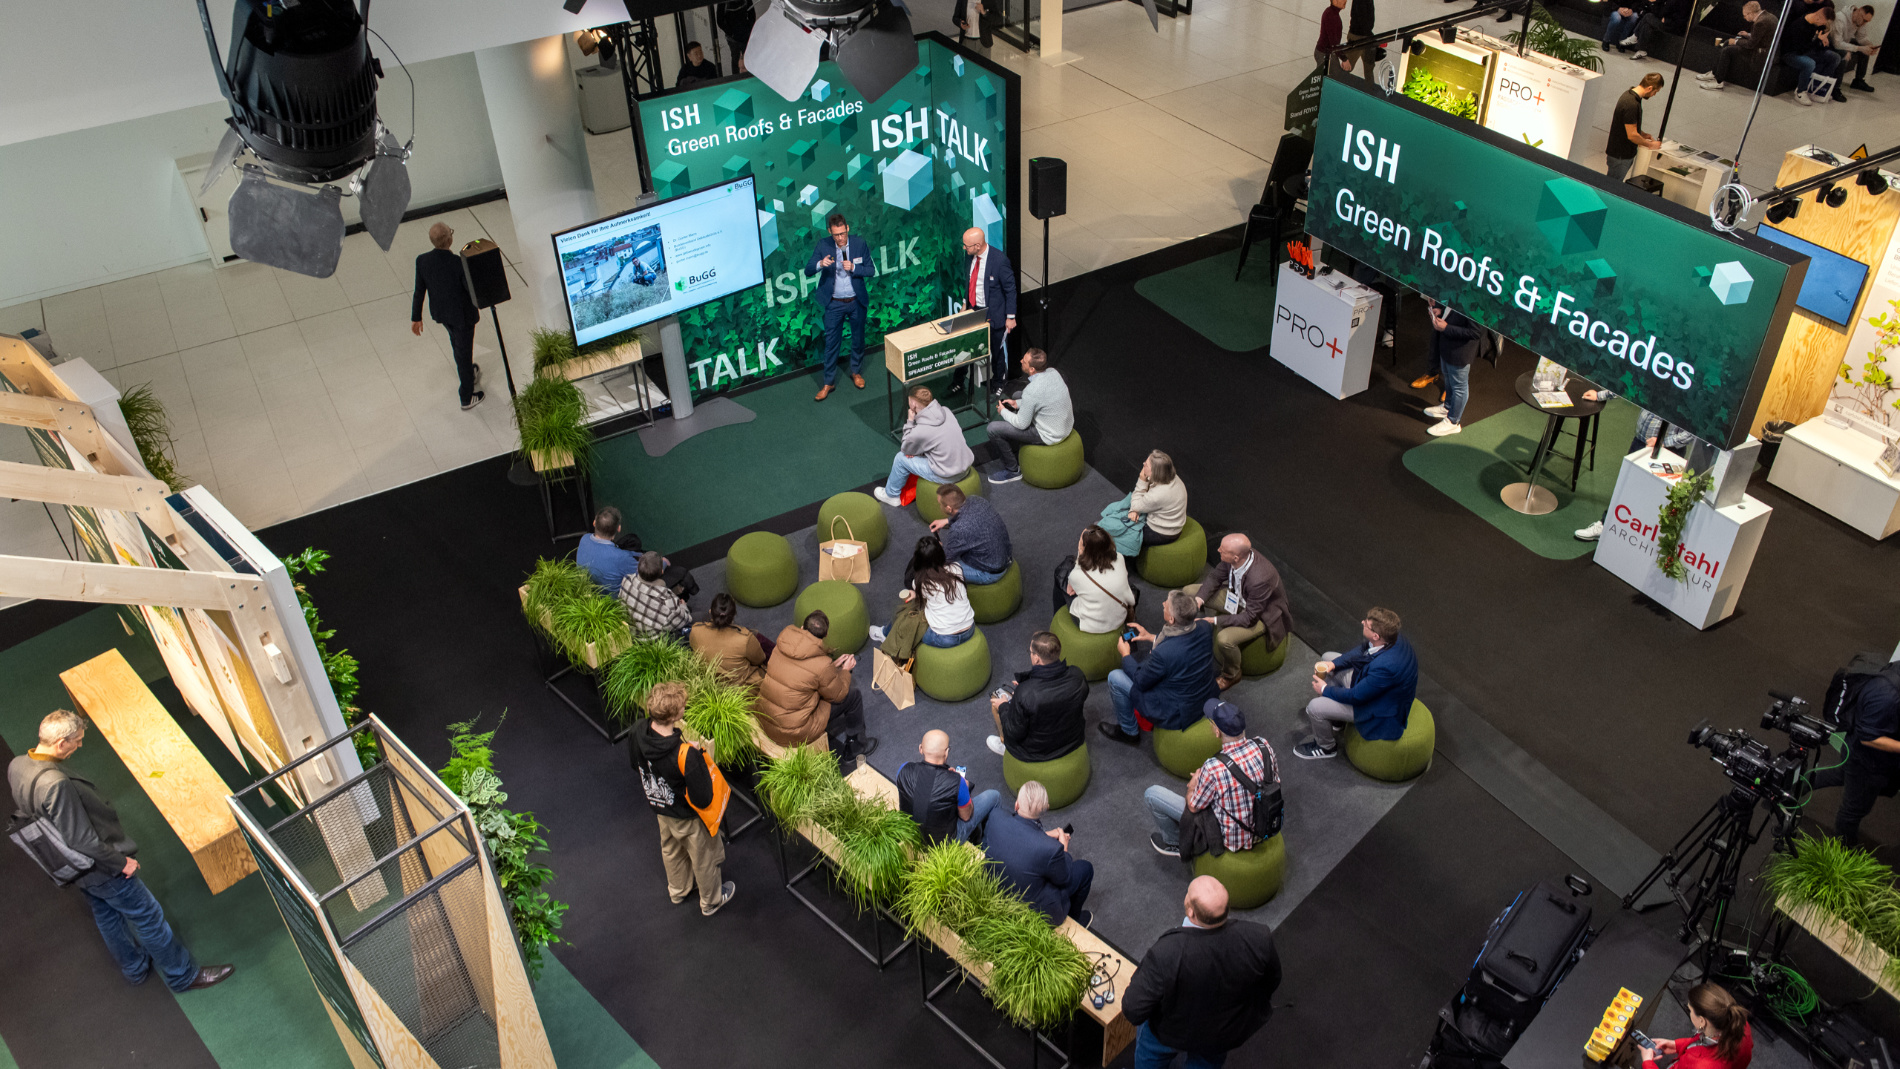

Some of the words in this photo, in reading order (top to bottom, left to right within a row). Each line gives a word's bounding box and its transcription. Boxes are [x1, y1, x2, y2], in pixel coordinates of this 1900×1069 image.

[1311, 75, 1321, 84] ISH
[1500, 78, 1545, 105] PRO+
[661, 103, 701, 132] ISH
[668, 133, 720, 156] Green
[725, 118, 774, 143] Roofs
[779, 113, 792, 131] &
[797, 100, 863, 127] Facades
[1290, 111, 1303, 119] Stand
[871, 107, 929, 152] ISH
[936, 108, 990, 173] TALK
[1341, 122, 1401, 184] ISH
[735, 180, 752, 190] BuGG
[560, 235, 576, 244] Vielen
[577, 230, 591, 239] Dank
[591, 227, 599, 235] für
[599, 224, 610, 232] Ihre
[689, 268, 717, 285] BuGG
[765, 268, 822, 308] ISH
[1335, 188, 1411, 251] Green
[1421, 228, 1504, 296] Roofs
[1514, 275, 1542, 313] &
[1550, 290, 1695, 390] Facades
[1353, 304, 1375, 316] PRO+
[1276, 304, 1343, 359] PRO+
[689, 337, 783, 390] TALK
[907, 353, 918, 361] ISH
[908, 359, 920, 367] Green
[921, 354, 934, 362] Roofs
[939, 348, 956, 357] Facades
[934, 358, 954, 368] CORNER
[1614, 504, 1659, 542] Carl
[1677, 542, 1720, 579] tahl
